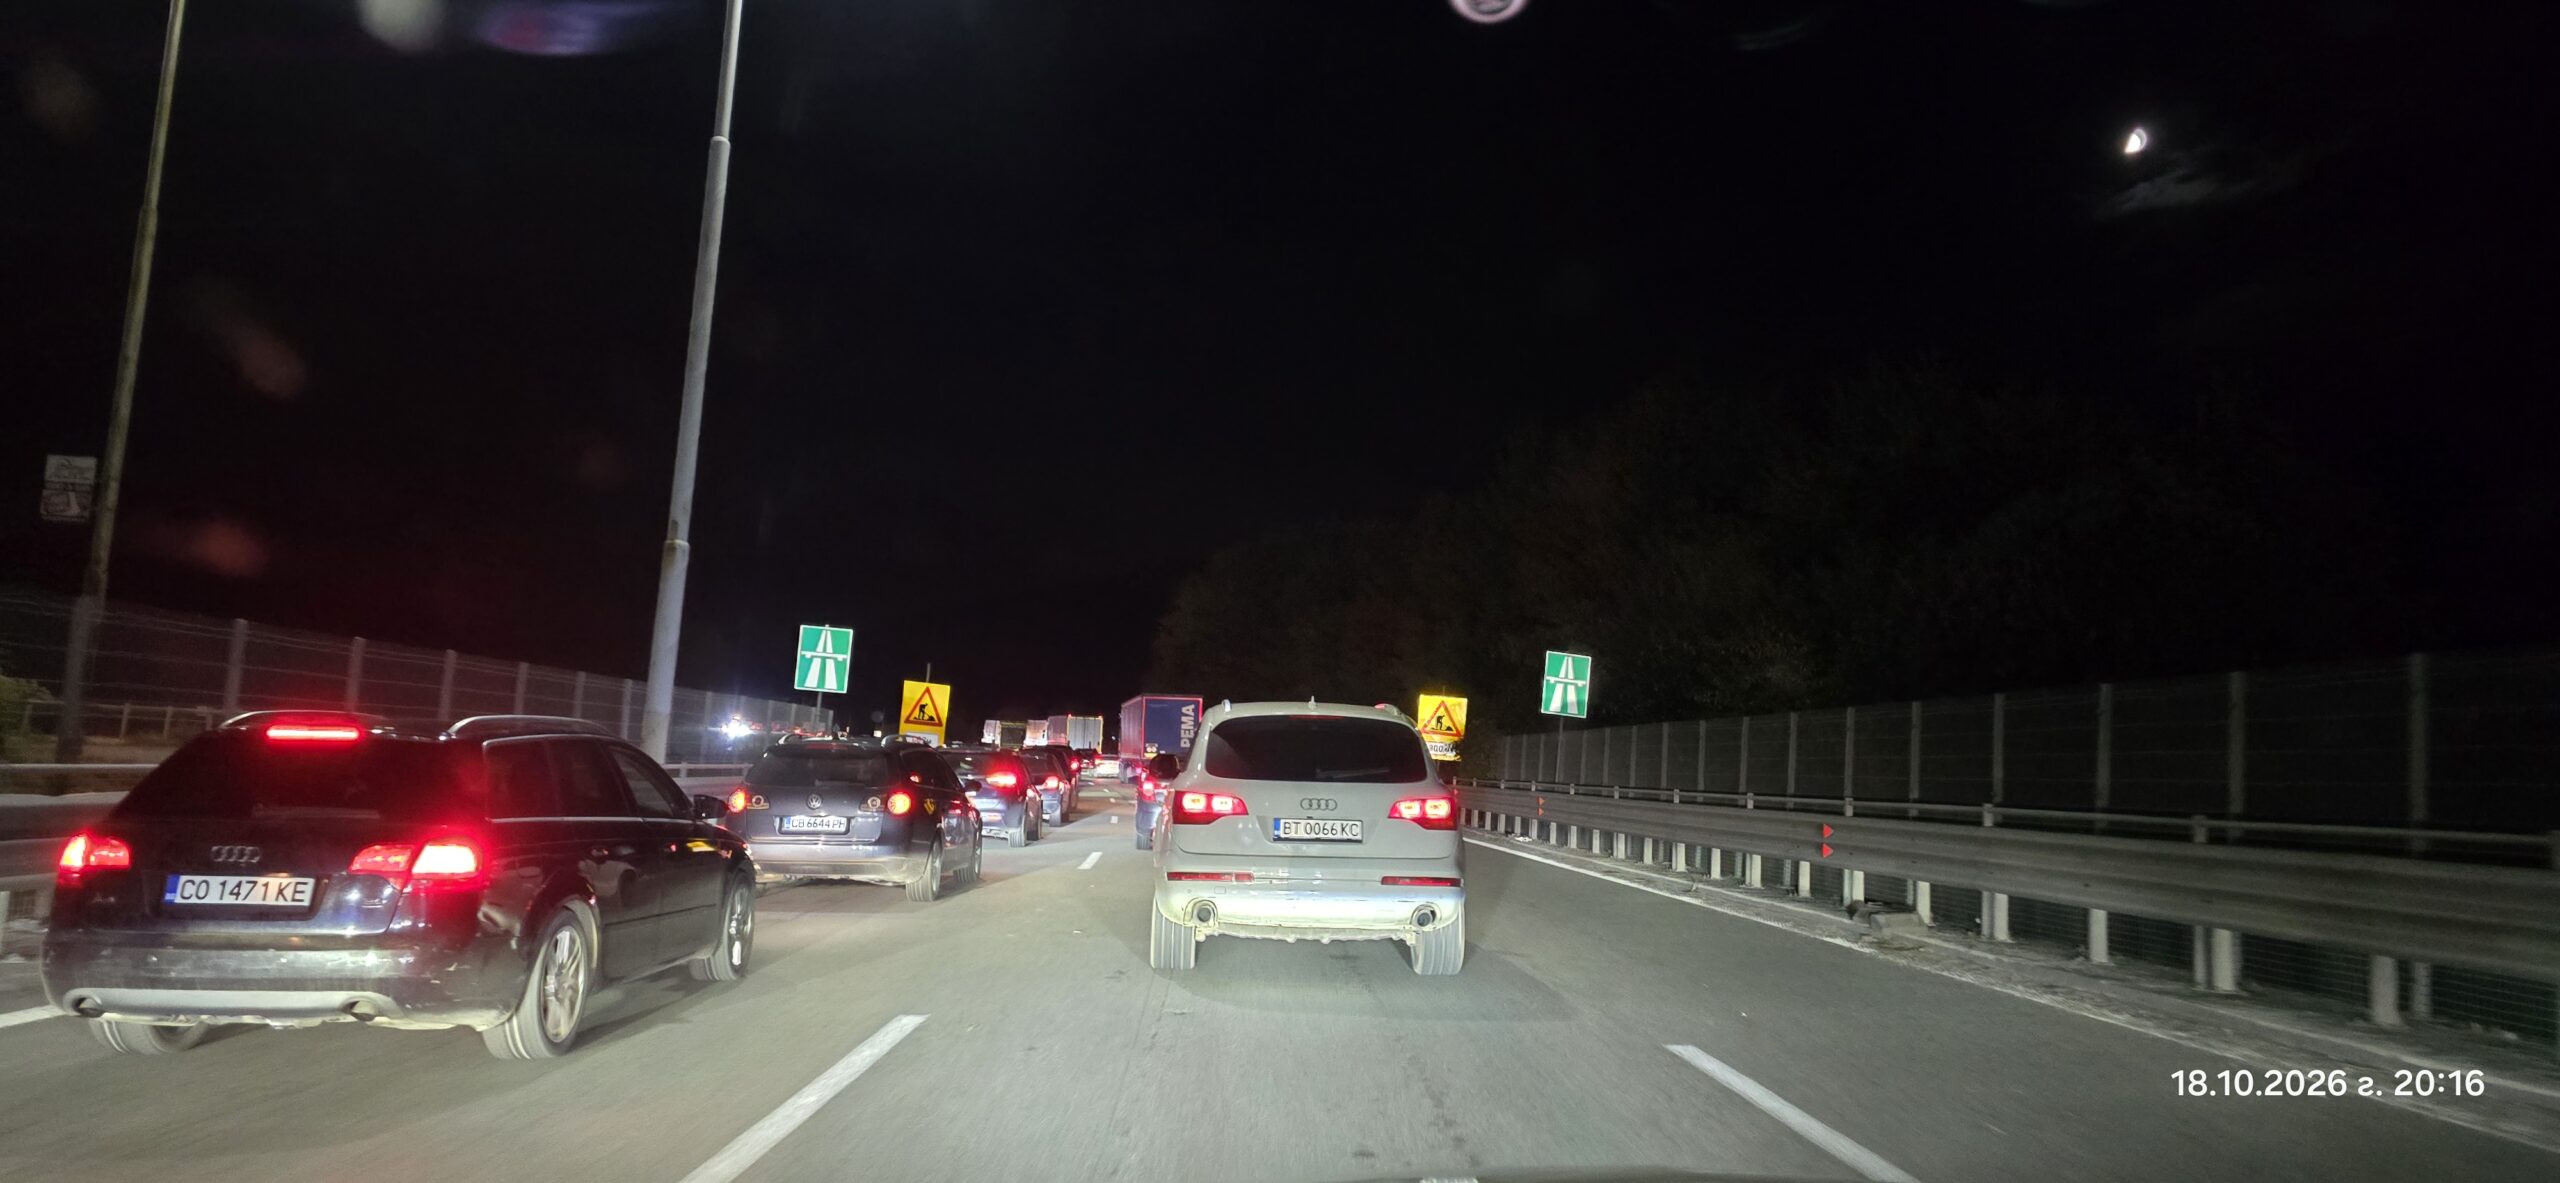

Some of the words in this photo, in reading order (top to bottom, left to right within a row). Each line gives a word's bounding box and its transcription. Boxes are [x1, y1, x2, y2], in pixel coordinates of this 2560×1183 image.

[1180, 704, 1195, 748] PEMA
[1283, 821, 1301, 835] BT
[1304, 822, 1338, 836] 0066
[1341, 823, 1359, 837] KC
[180, 879, 210, 900] CO
[219, 880, 270, 901] 1471
[275, 881, 309, 903] KE
